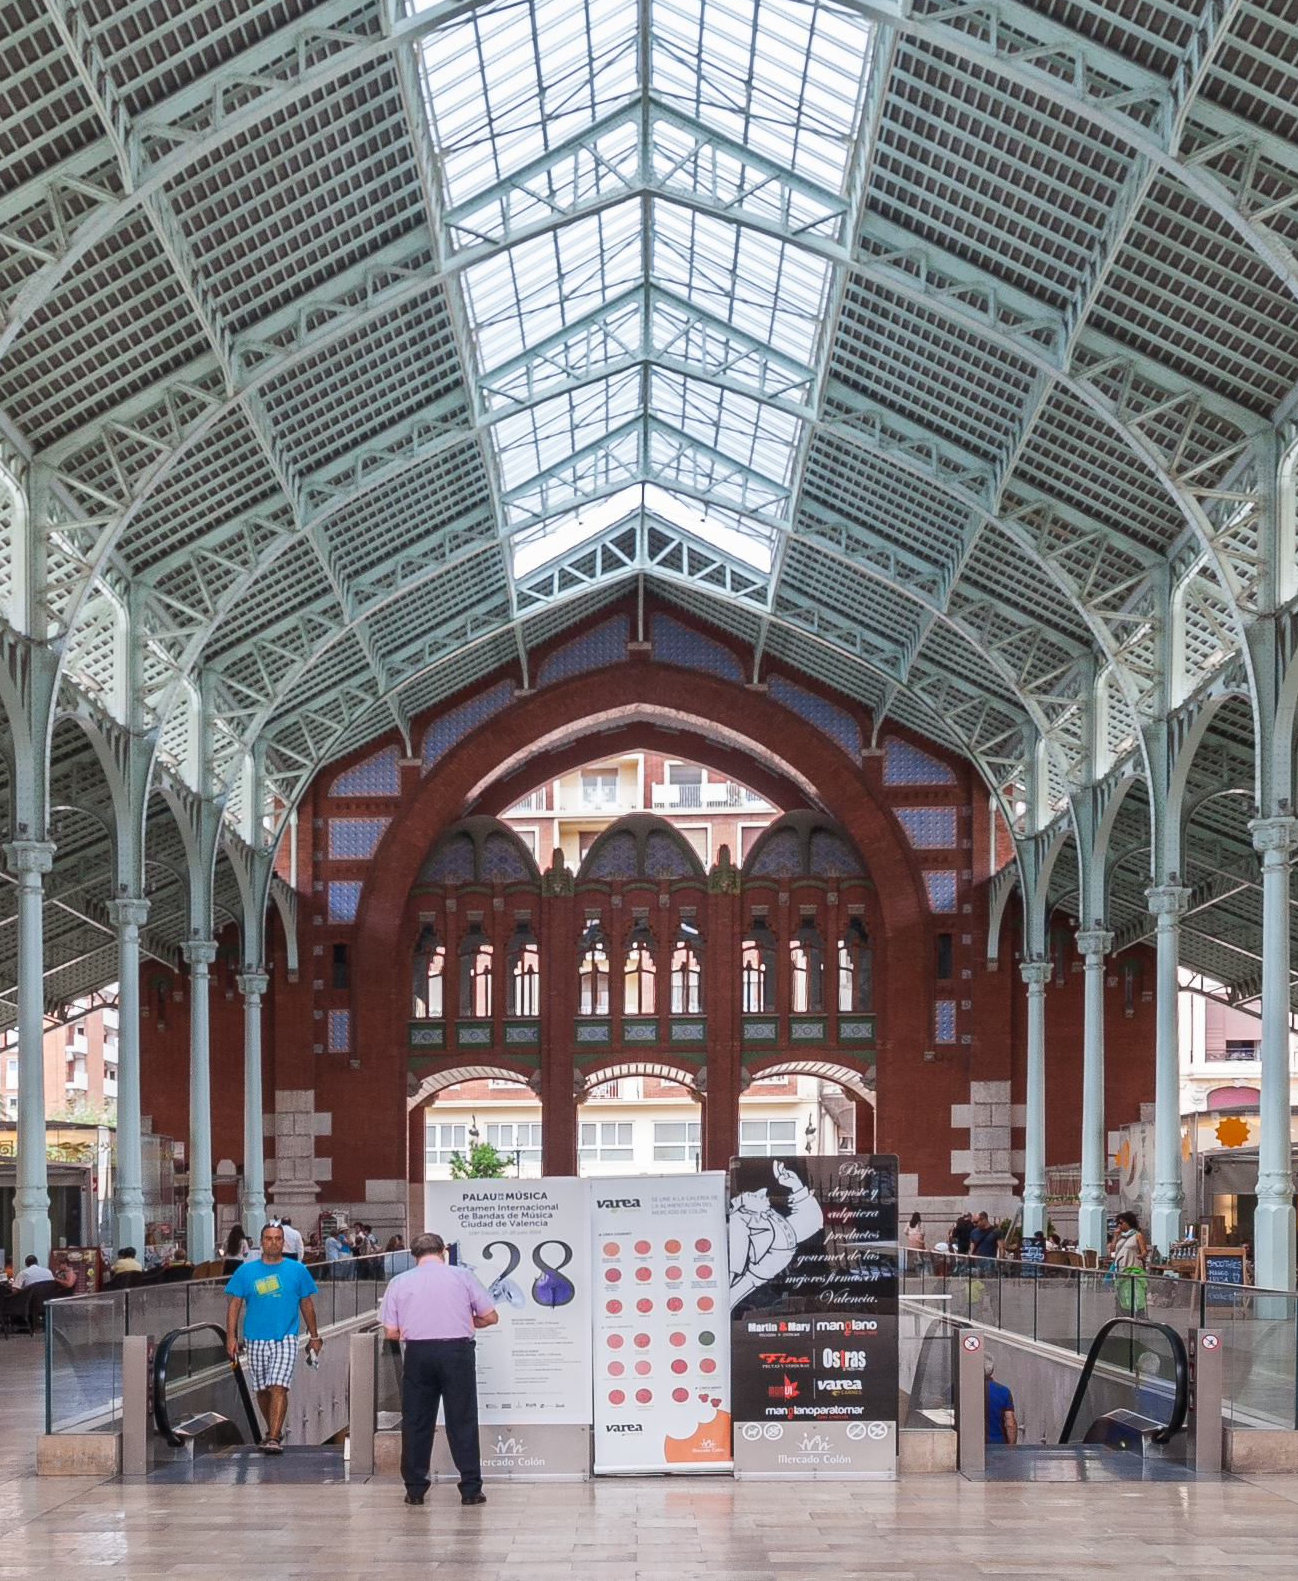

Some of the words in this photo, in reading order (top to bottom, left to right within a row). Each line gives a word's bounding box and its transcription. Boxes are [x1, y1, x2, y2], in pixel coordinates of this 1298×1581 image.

[462, 1193, 497, 1201] PALAU
[505, 1190, 548, 1200] MÚSICA
[828, 1186, 869, 1202] deguste
[870, 1188, 878, 1200] y
[450, 1204, 495, 1213] Certamen
[497, 1203, 559, 1212] Internacional
[596, 1198, 641, 1209] varea
[458, 1212, 470, 1220] de
[472, 1212, 505, 1220] Bandas
[521, 1210, 553, 1219] Música
[460, 1220, 493, 1228] Ciudad
[510, 1219, 548, 1227] Valencia
[823, 1228, 879, 1245] productos
[793, 1252, 845, 1268] gourmet
[847, 1249, 861, 1261] de
[863, 1249, 880, 1260] las
[785, 1274, 826, 1289] mejores
[821, 1269, 861, 1287] firmas
[820, 1288, 878, 1305] Valencia.
[748, 1322, 778, 1333] Martin
[779, 1321, 787, 1332] &
[788, 1322, 811, 1333] Mary
[816, 1320, 878, 1336] manglano
[759, 1353, 811, 1363] Fina
[823, 1348, 866, 1368] Ostras
[817, 1379, 862, 1390] varea
[765, 1405, 864, 1419] manglanoparatomar
[606, 1423, 643, 1432] varea
[517, 1456, 545, 1467] Colón
[778, 1454, 820, 1464] Mercado
[823, 1454, 852, 1464] Colón
